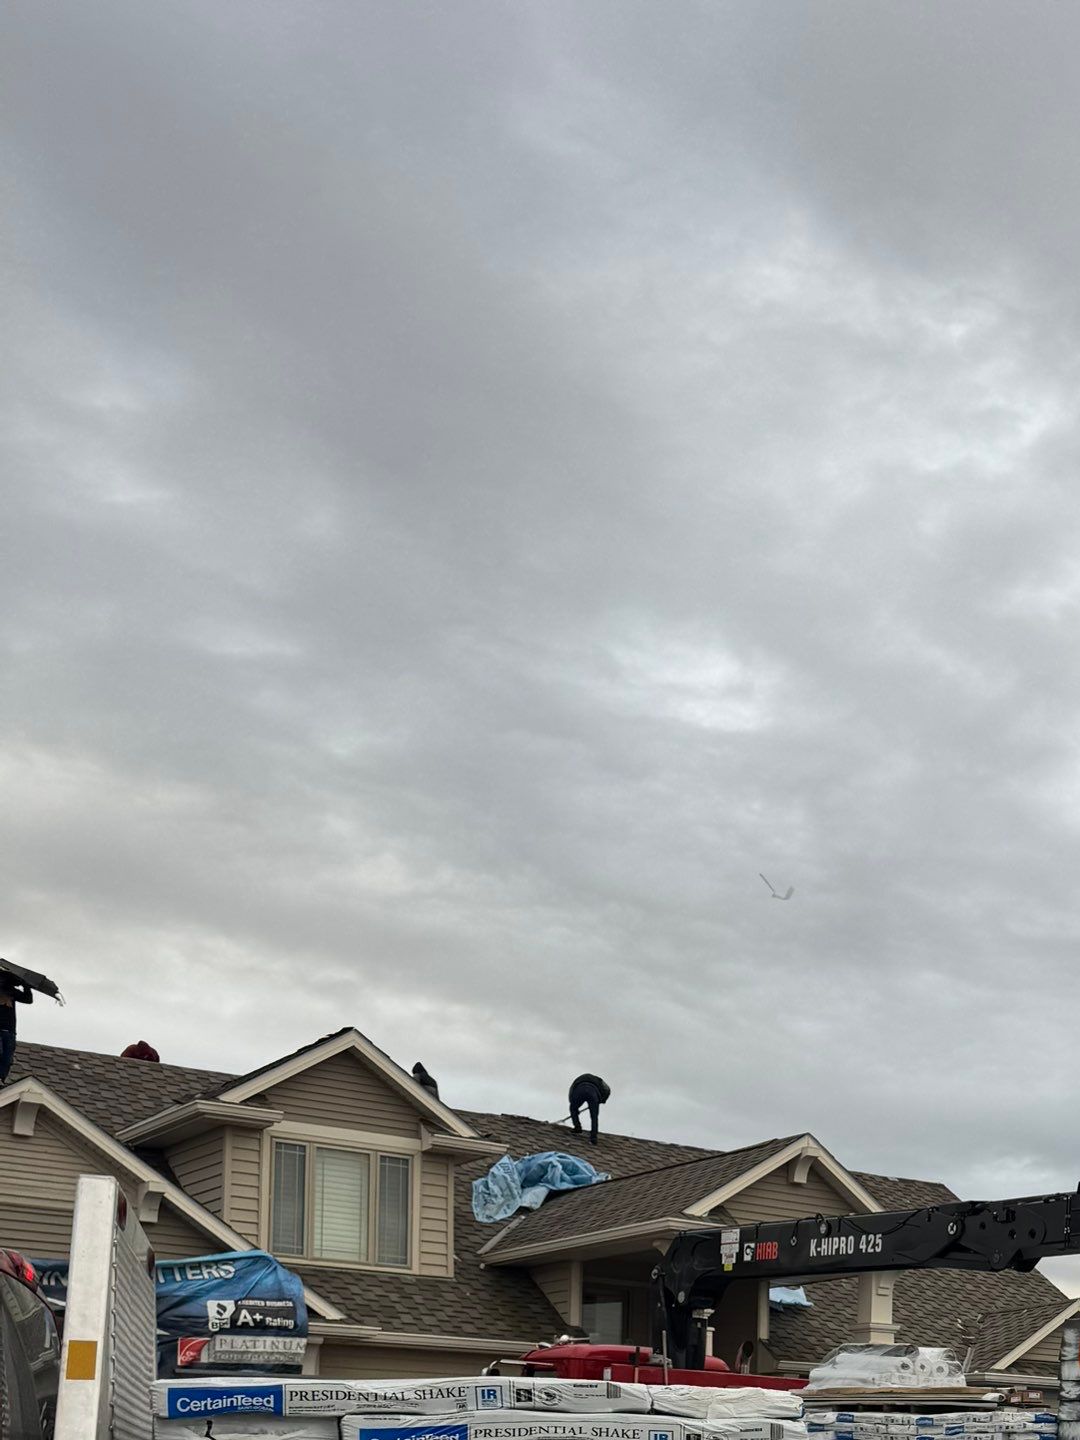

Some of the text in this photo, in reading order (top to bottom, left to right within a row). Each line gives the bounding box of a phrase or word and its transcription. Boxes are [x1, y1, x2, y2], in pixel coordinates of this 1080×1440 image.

[756, 1241, 779, 1261] HIAB
[809, 1233, 883, 1258] K-HIPRO 425
[236, 1309, 264, 1327] A+
[414, 1386, 467, 1400] SHAKE
[176, 1394, 274, 1413] CertainTeed
[474, 1425, 640, 1439] PRESIDENTIAL SHAKE
